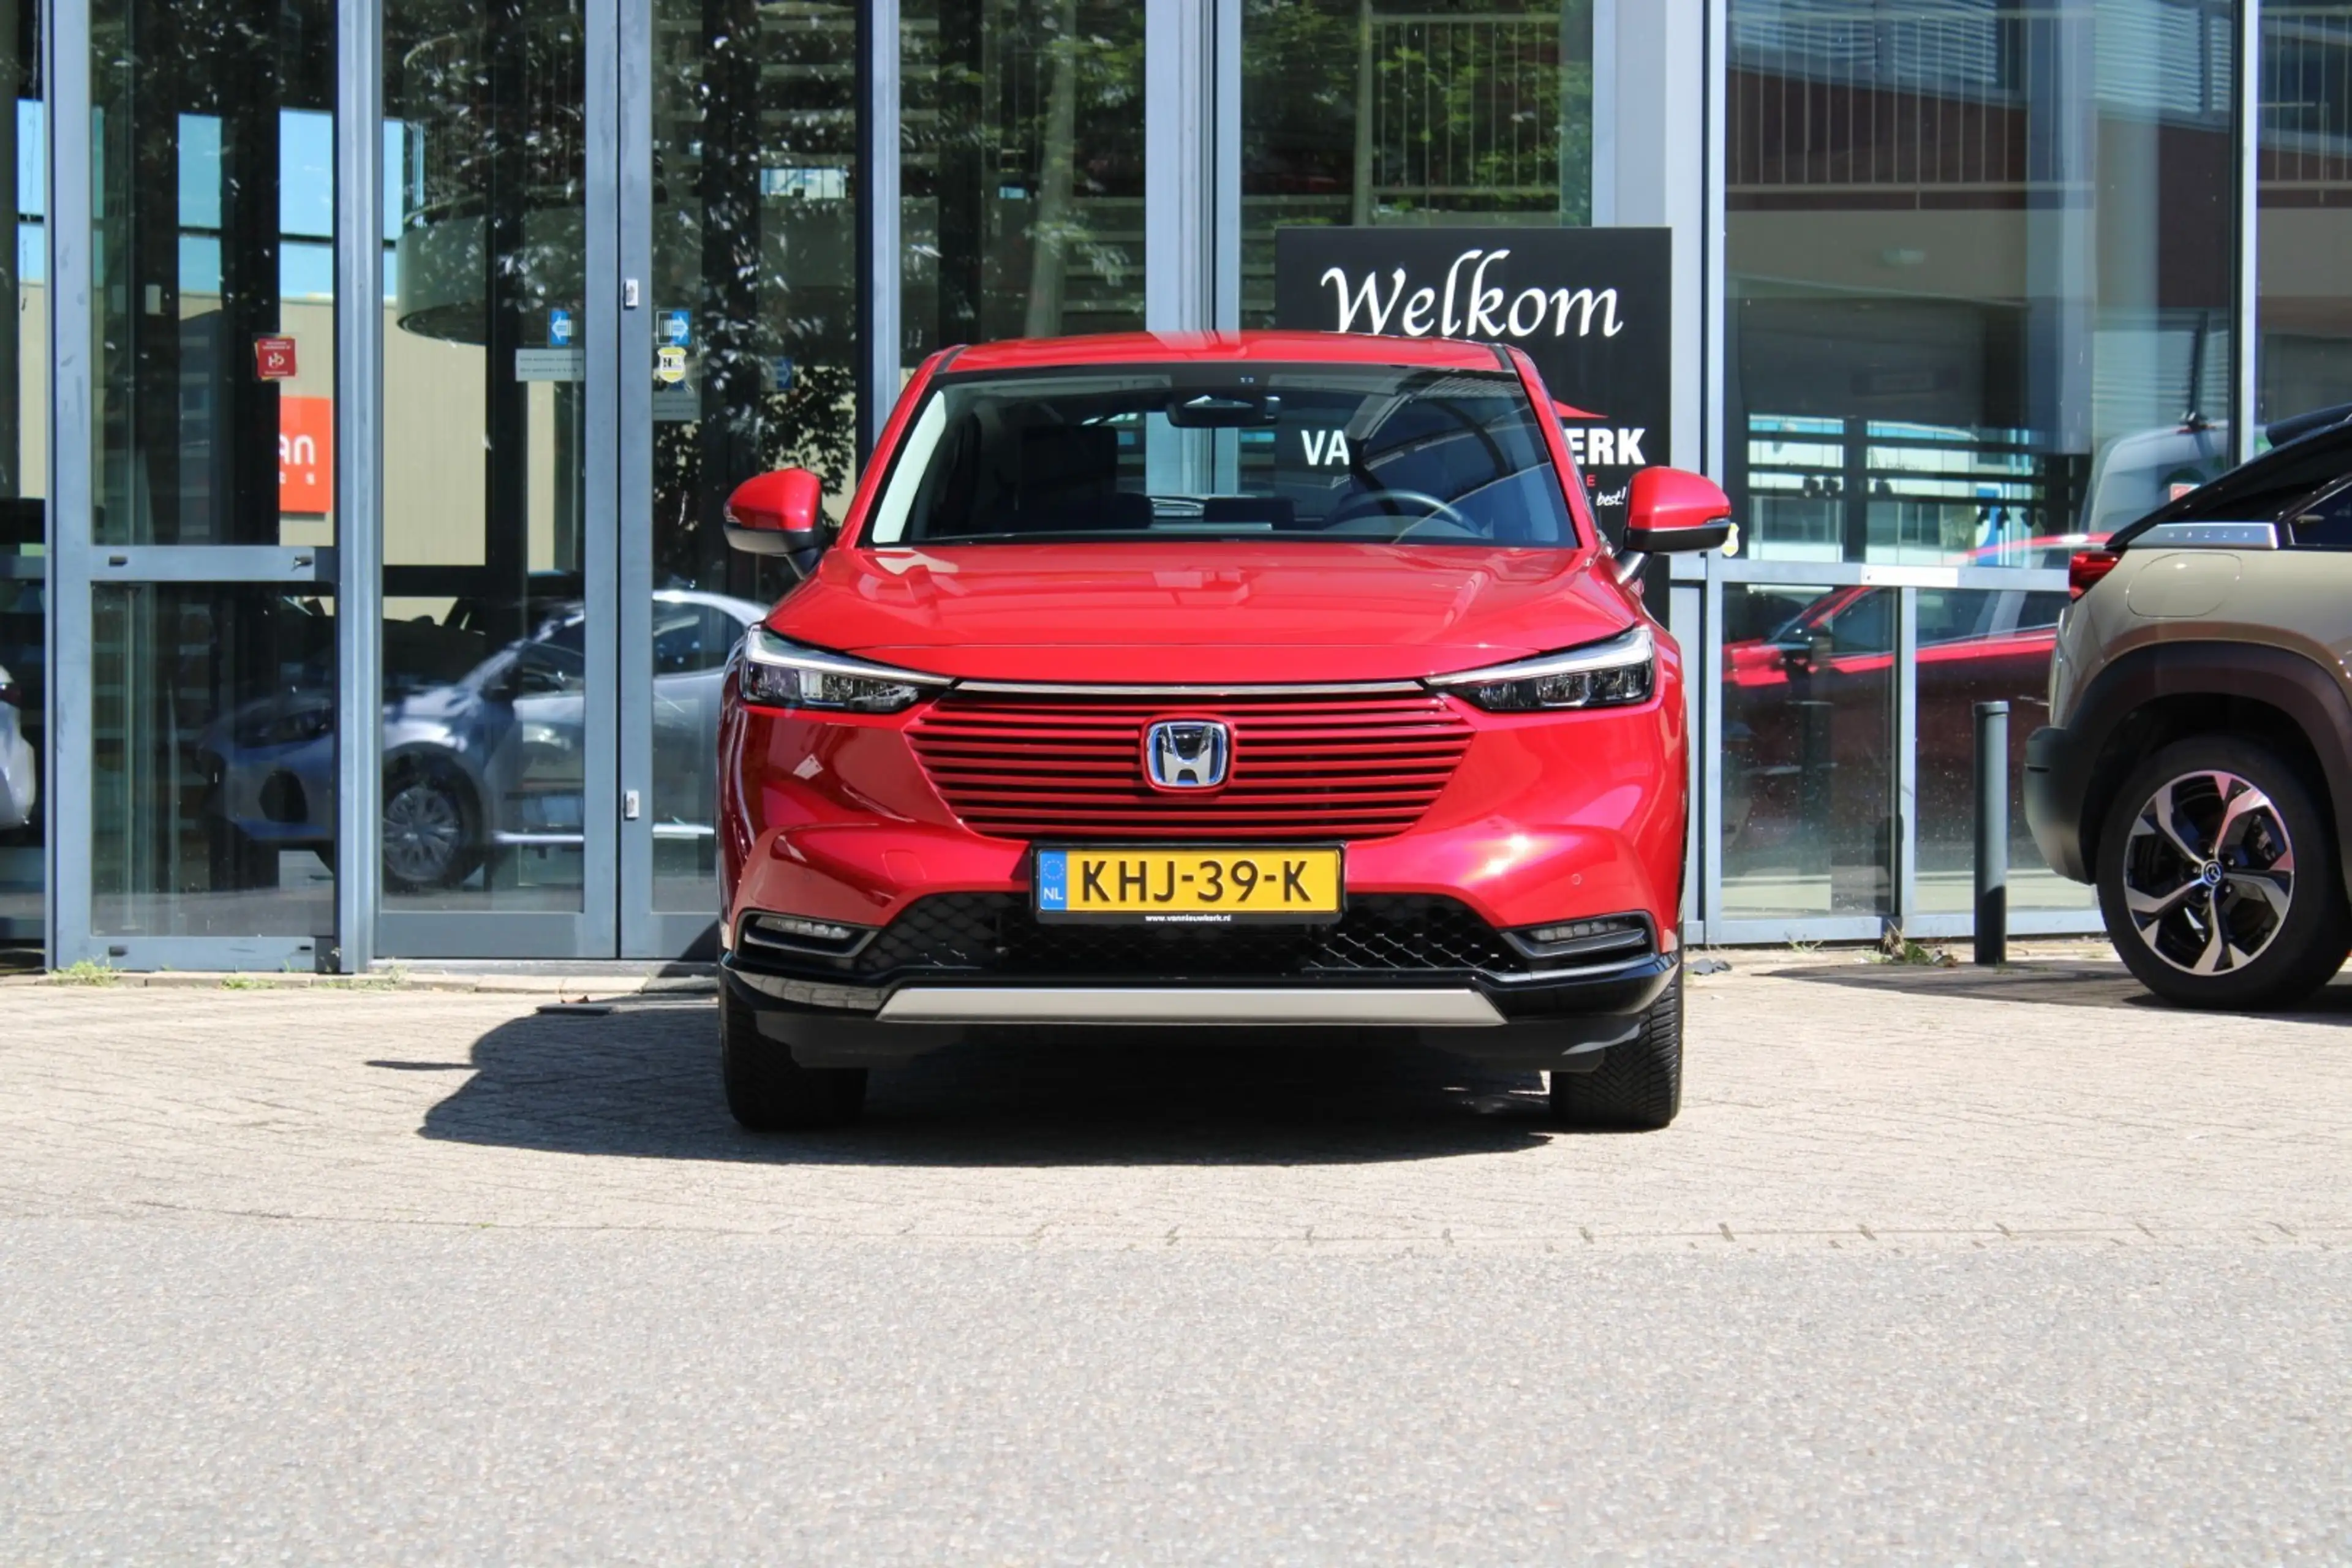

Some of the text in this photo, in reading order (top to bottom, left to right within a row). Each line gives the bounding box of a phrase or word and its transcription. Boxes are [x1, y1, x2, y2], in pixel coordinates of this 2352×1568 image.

[1321, 249, 1624, 337] Welkom
[1596, 486, 1627, 506] best!
[1043, 888, 1063, 900] NL
[1082, 860, 1312, 903] KHJ-39-K
